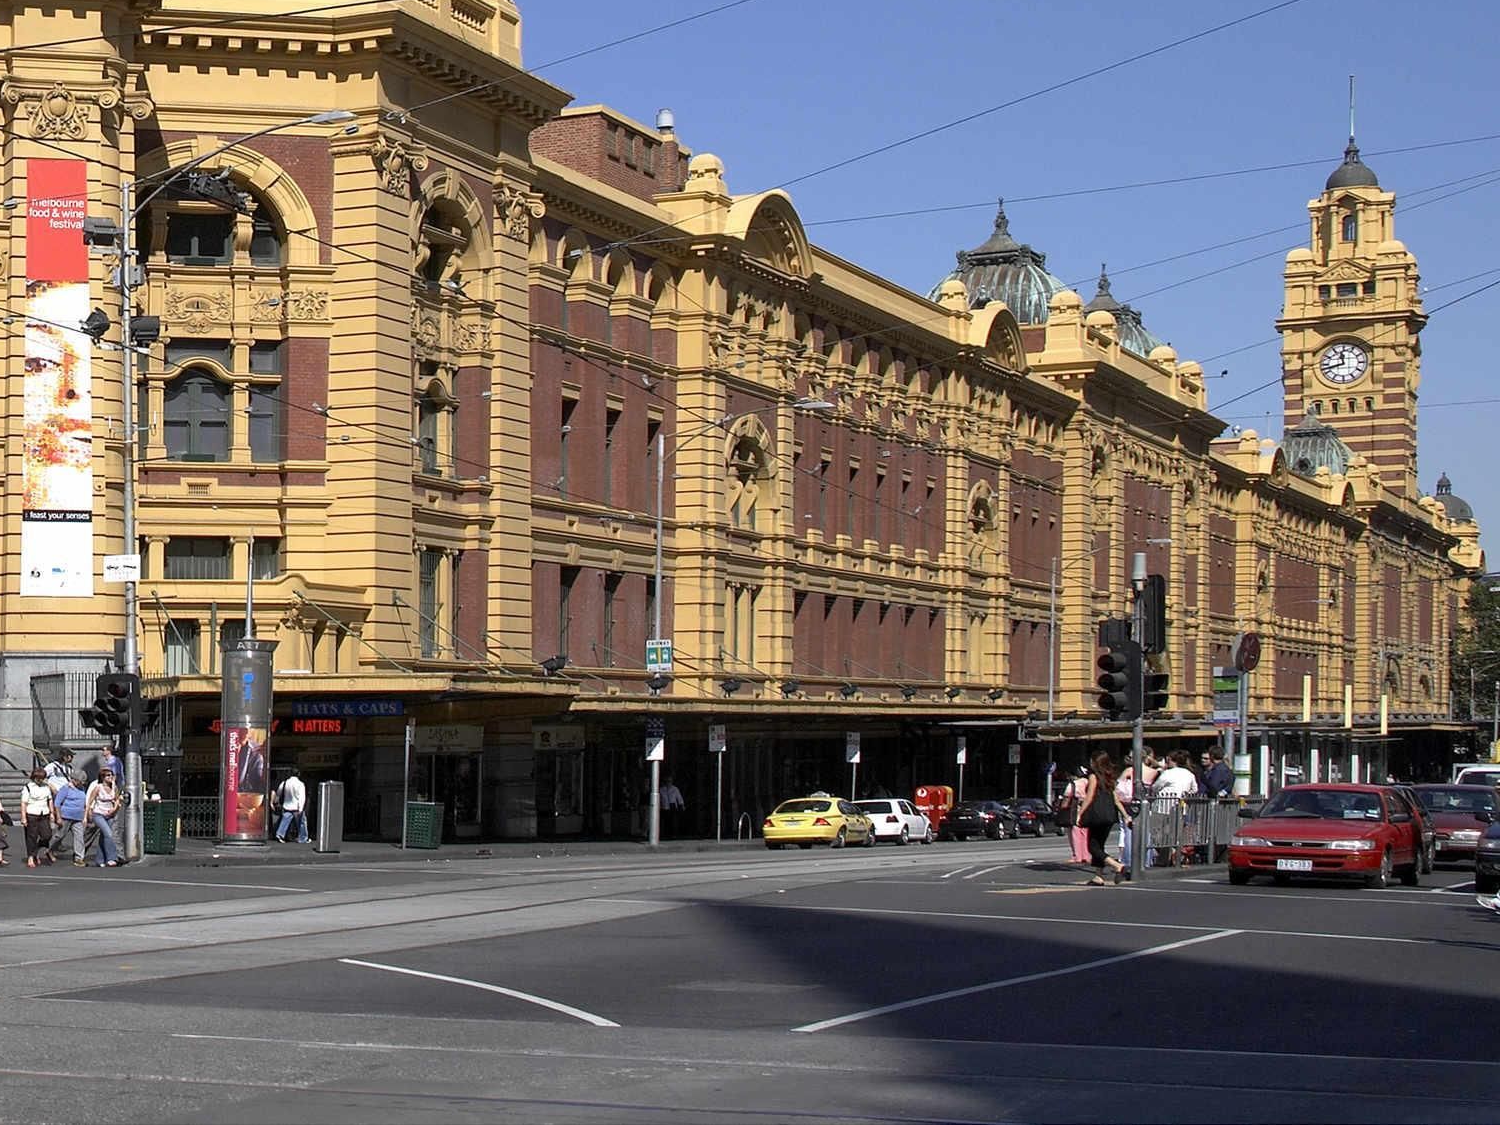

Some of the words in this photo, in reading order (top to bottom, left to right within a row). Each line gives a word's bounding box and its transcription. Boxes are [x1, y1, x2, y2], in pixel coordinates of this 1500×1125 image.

[31, 198, 85, 209] melbourne
[28, 207, 50, 218] food
[51, 208, 60, 218] &
[61, 209, 85, 219] wine
[49, 218, 85, 230] festival
[29, 511, 47, 520] feast
[48, 512, 65, 521] your
[66, 512, 90, 520] senses
[296, 702, 334, 716] HATS
[343, 702, 355, 715] &
[358, 701, 397, 714] CAPS
